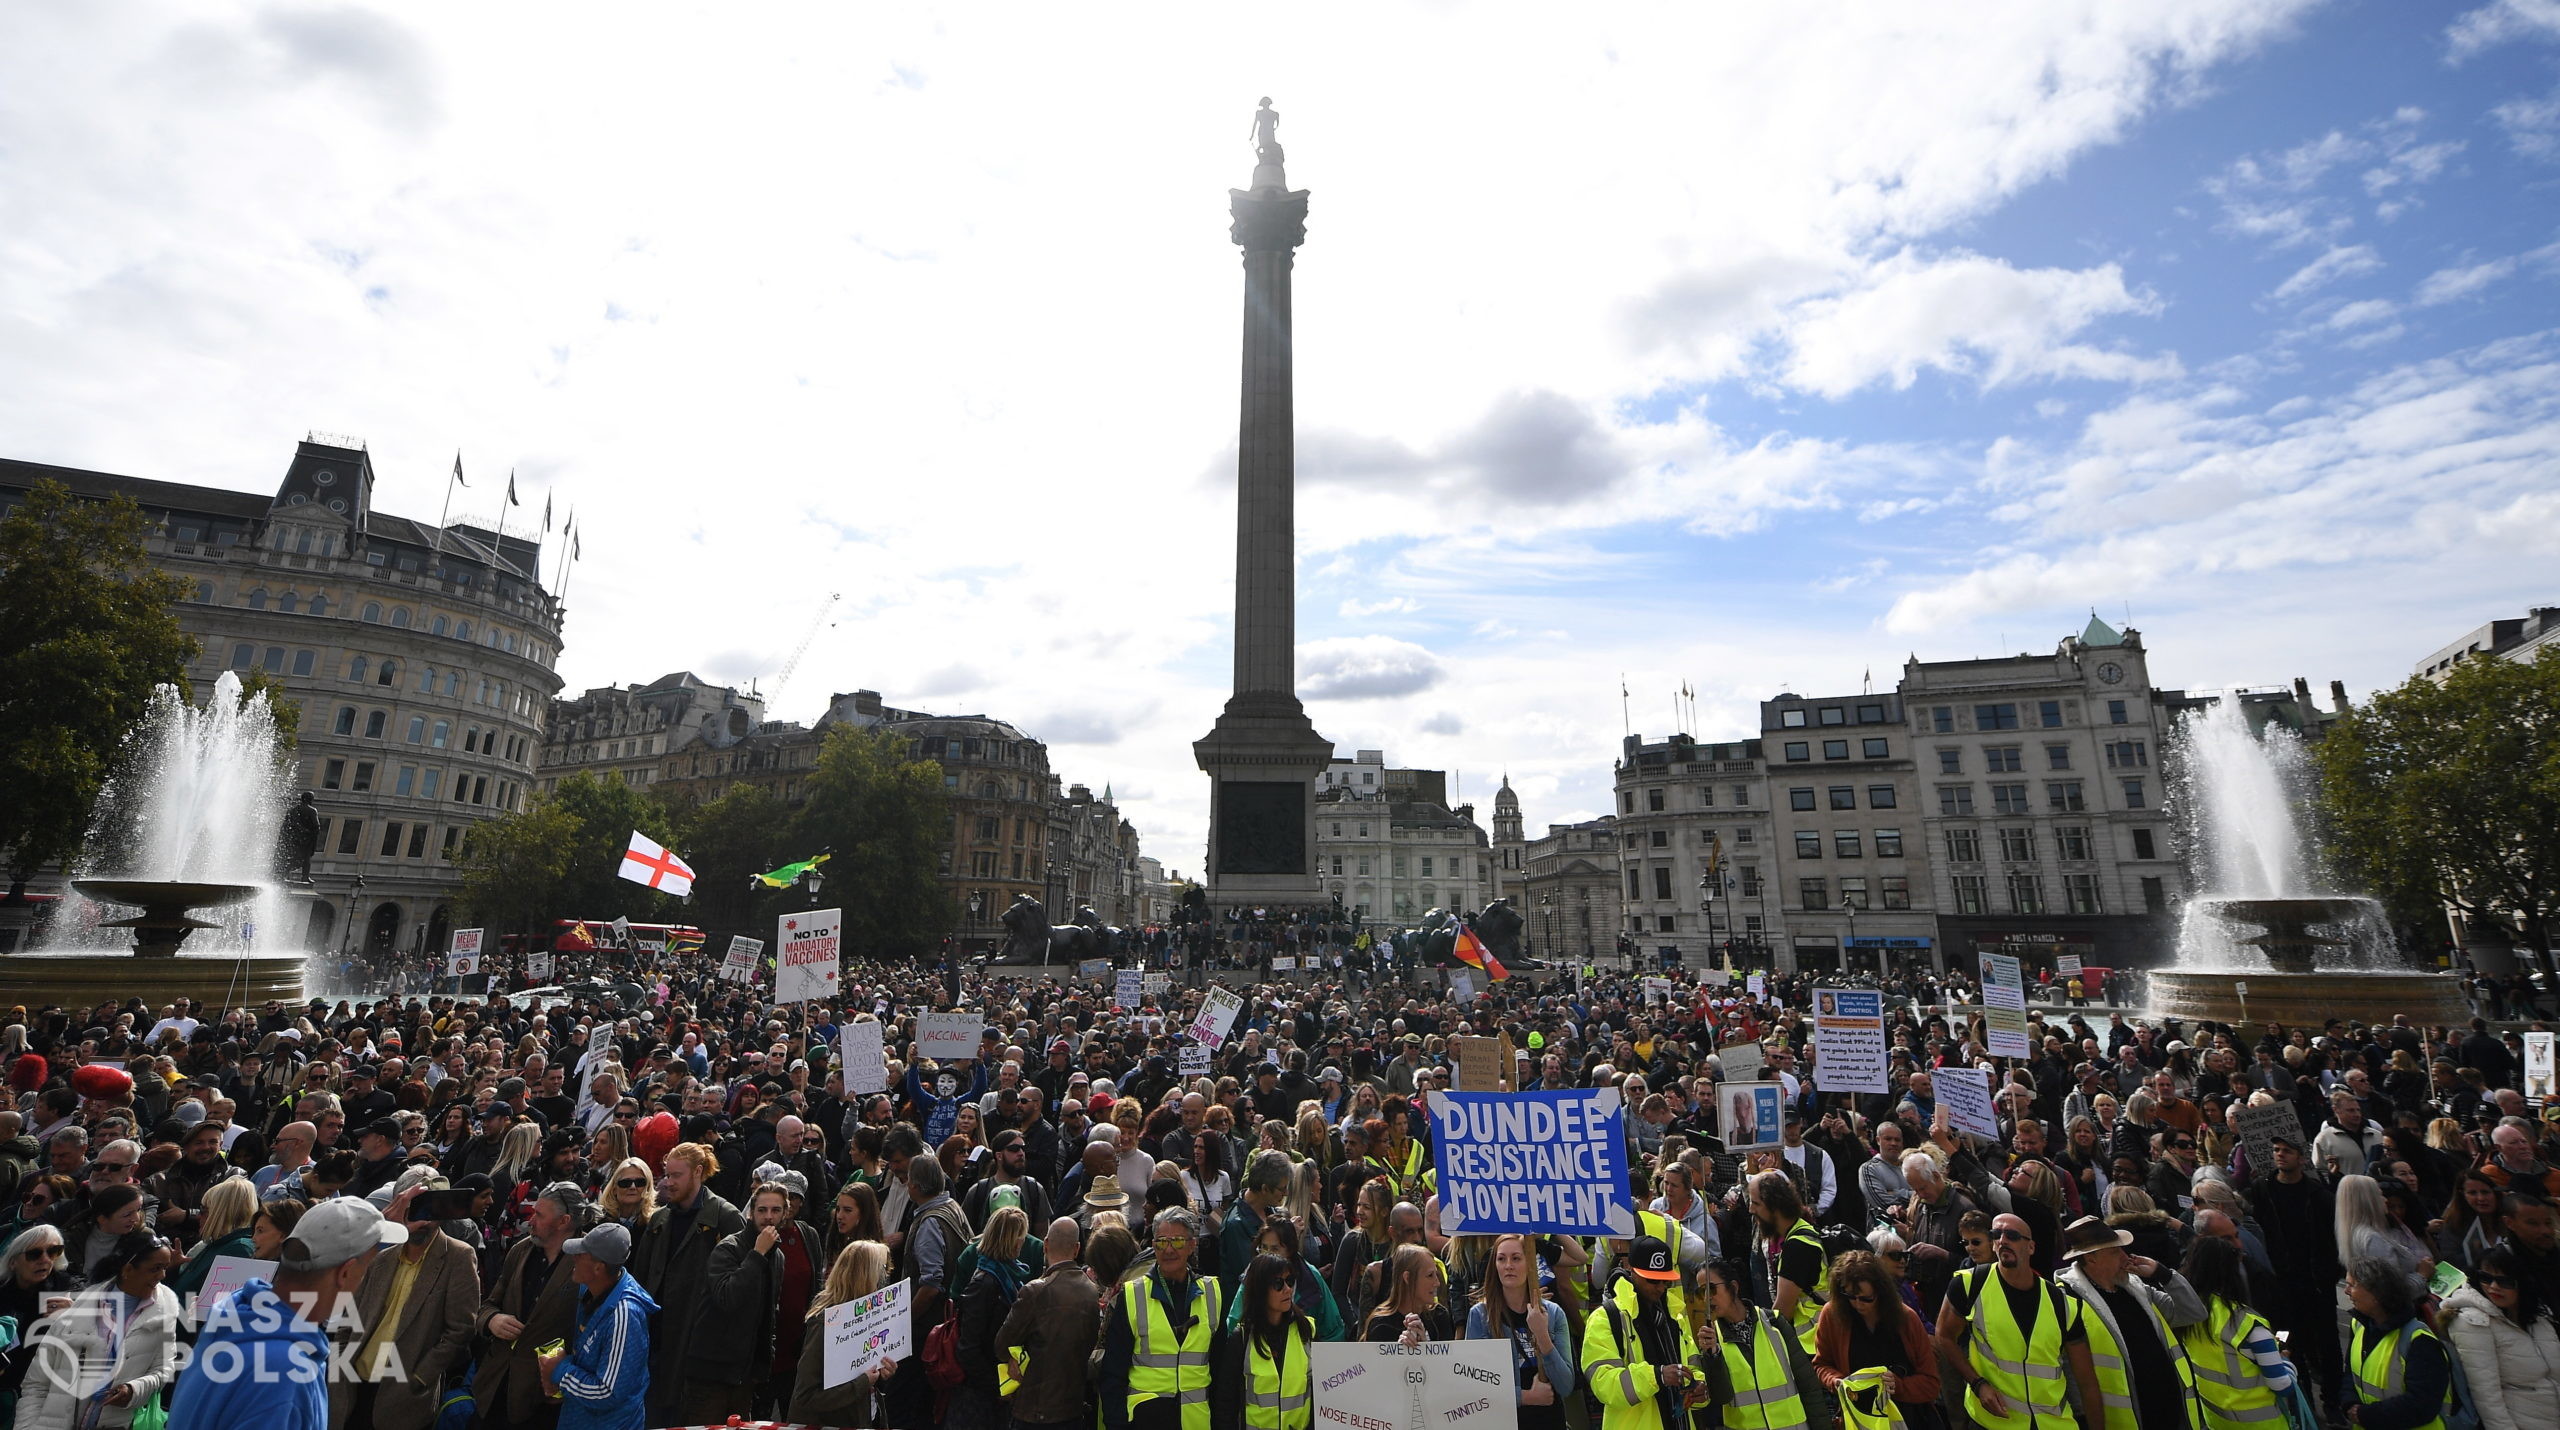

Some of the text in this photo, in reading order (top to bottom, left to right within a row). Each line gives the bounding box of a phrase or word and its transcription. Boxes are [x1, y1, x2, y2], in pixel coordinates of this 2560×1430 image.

[457, 934, 477, 944] MEDIA
[794, 929, 828, 940] NO TO
[786, 937, 838, 953] MANDATORY
[785, 948, 836, 967] VACCINES
[1204, 1001, 1215, 1013] IS
[928, 1014, 979, 1025] FUCK YOUR
[1199, 1011, 1218, 1030] THE
[923, 1030, 970, 1042] VACCINE
[1442, 1098, 1608, 1142] DUNDEE
[2264, 1130, 2273, 1138] US
[2275, 1126, 2286, 1135] TO
[1446, 1142, 1611, 1181] RESISTANCE
[1448, 1180, 1614, 1226] MOVEMENT
[854, 1292, 884, 1317] WAKE
[843, 1316, 863, 1329] BEFORE
[863, 1328, 889, 1354] NOT
[1379, 1344, 1450, 1356] SAVE US NOW
[851, 1354, 871, 1370] ABOUT
[1321, 1363, 1367, 1392] INSOMNIA
[1453, 1363, 1501, 1386] CANCERS
[1319, 1405, 1347, 1424] NOSE
[1444, 1398, 1490, 1423] TINNITUS
